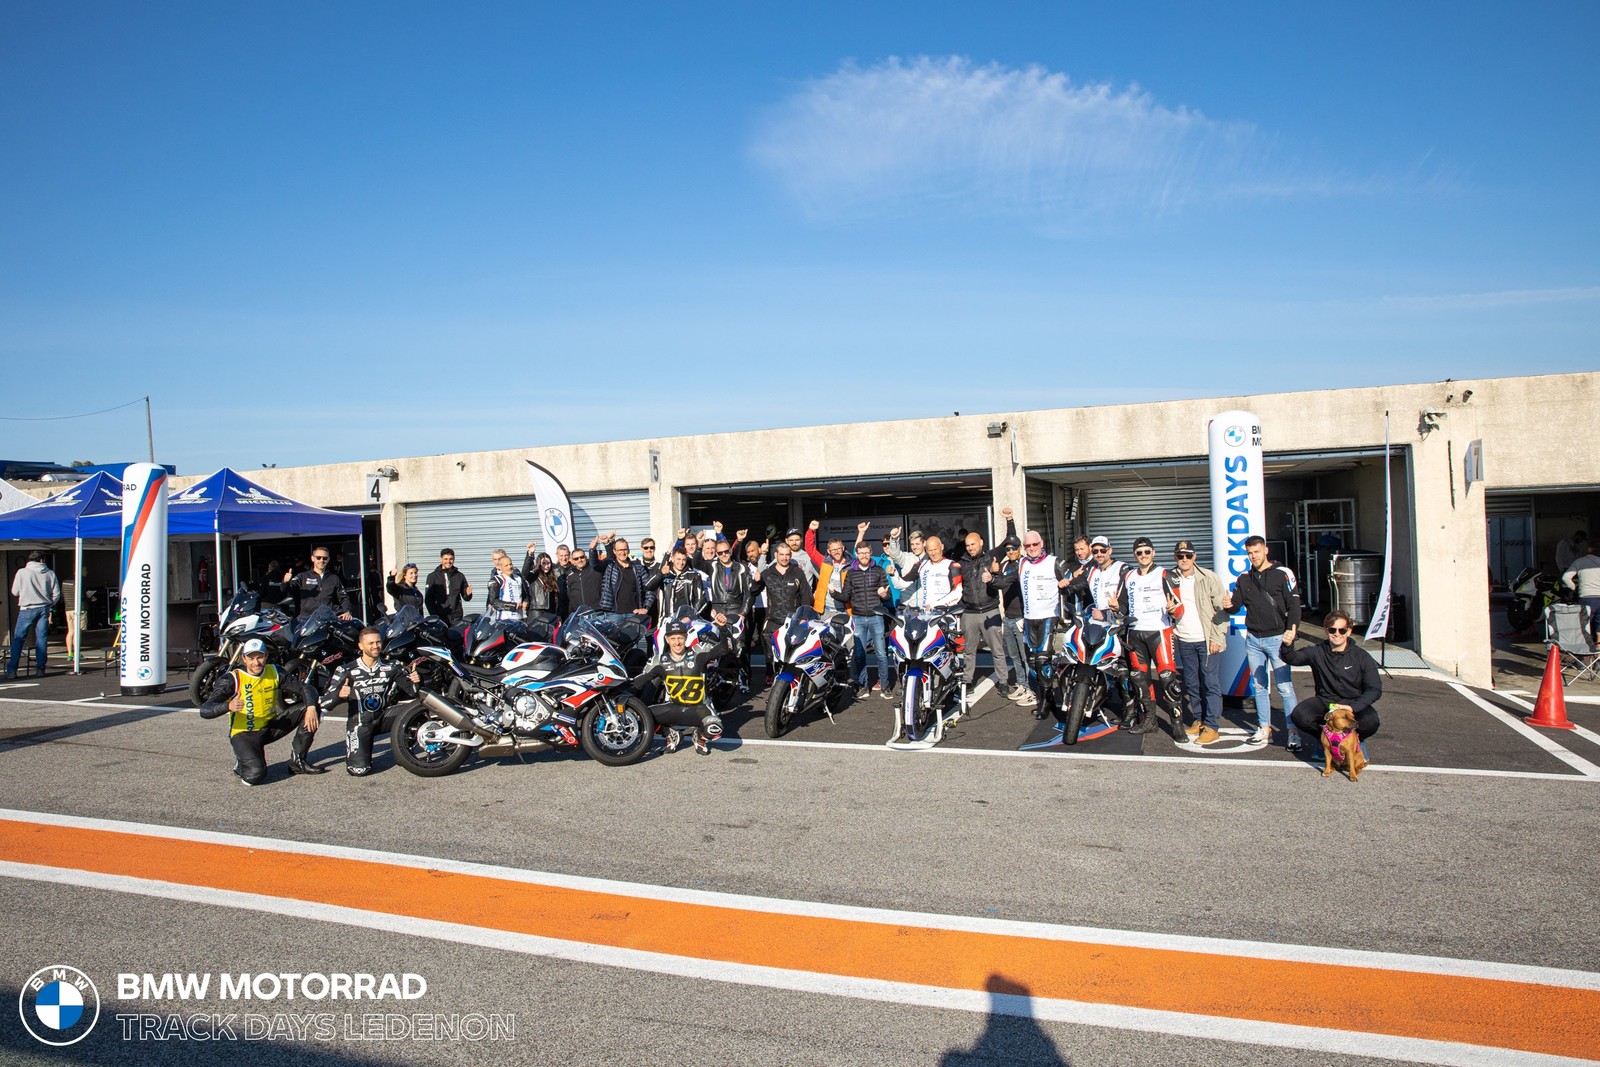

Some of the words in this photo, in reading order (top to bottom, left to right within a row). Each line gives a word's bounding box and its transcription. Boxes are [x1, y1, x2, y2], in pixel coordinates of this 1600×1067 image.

[653, 455, 659, 482] 5
[1473, 447, 1480, 480] 7
[371, 478, 381, 502] 4
[1225, 455, 1250, 636] TCKDAYS
[140, 563, 151, 629] MOTORRAD
[140, 632, 150, 663] BMW
[665, 675, 704, 704] 78
[245, 683, 255, 731] RACKDAYS
